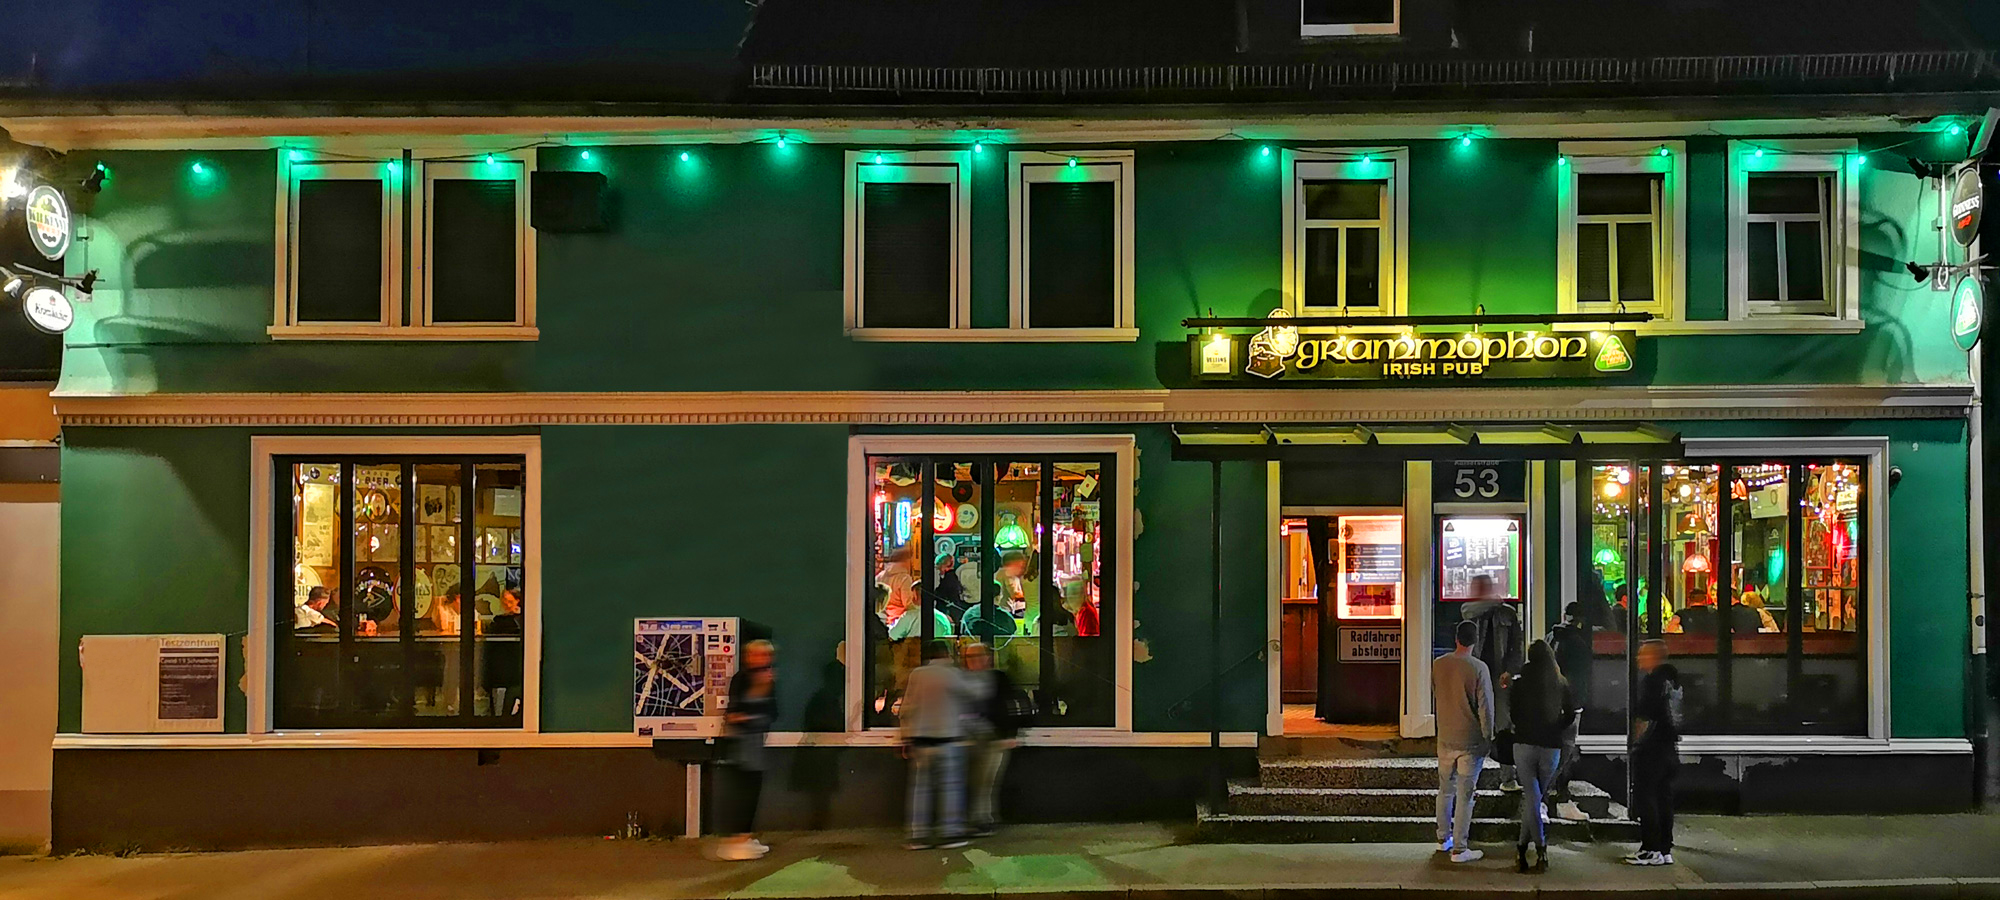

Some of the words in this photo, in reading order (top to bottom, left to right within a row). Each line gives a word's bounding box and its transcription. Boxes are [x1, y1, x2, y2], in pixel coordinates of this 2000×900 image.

[1295, 331, 1588, 369] grammophon
[1383, 362, 1436, 376] IRISH
[1442, 362, 1484, 376] PUB
[1454, 468, 1500, 498] 53
[160, 637, 220, 647] Testzentrum
[1350, 630, 1402, 643] Radfahrer
[1351, 644, 1402, 659] absteigen
